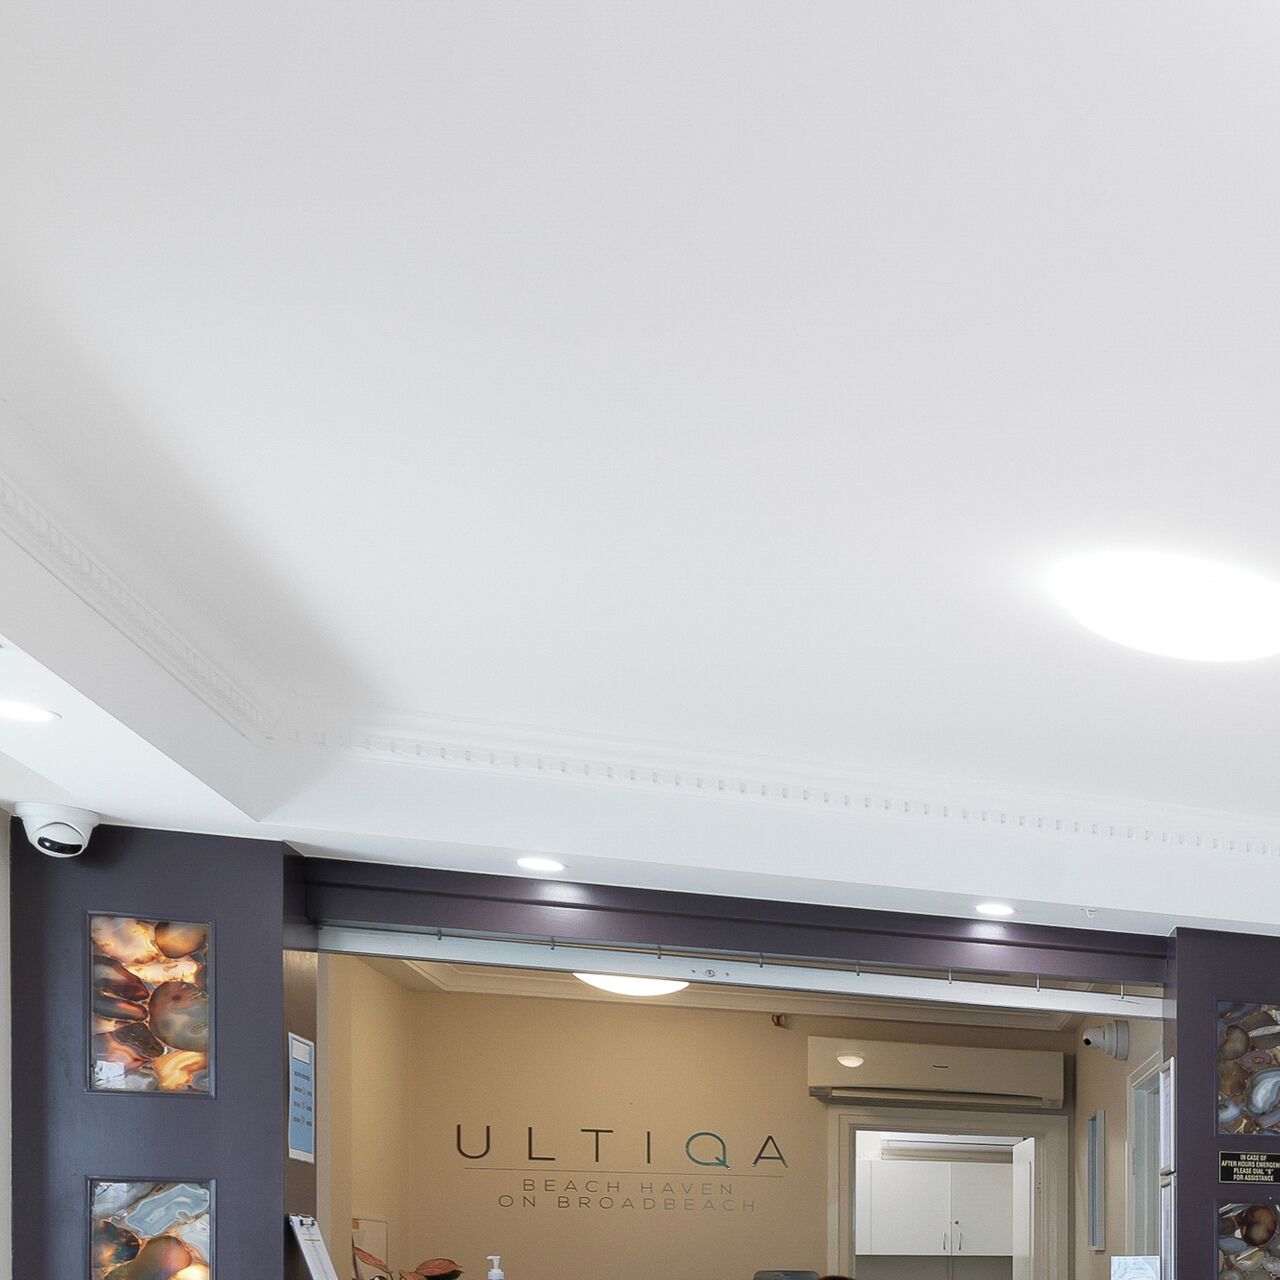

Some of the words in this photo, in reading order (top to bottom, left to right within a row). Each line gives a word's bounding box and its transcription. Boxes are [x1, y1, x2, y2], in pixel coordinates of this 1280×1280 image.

[456, 1124, 789, 1170] ULTIQA
[522, 1178, 621, 1194] BEACH
[640, 1181, 734, 1195] HAVEN
[1244, 1174, 1274, 1182] ASSISTANCE
[498, 1194, 537, 1208] ON
[557, 1195, 756, 1213] BROADBEACH
